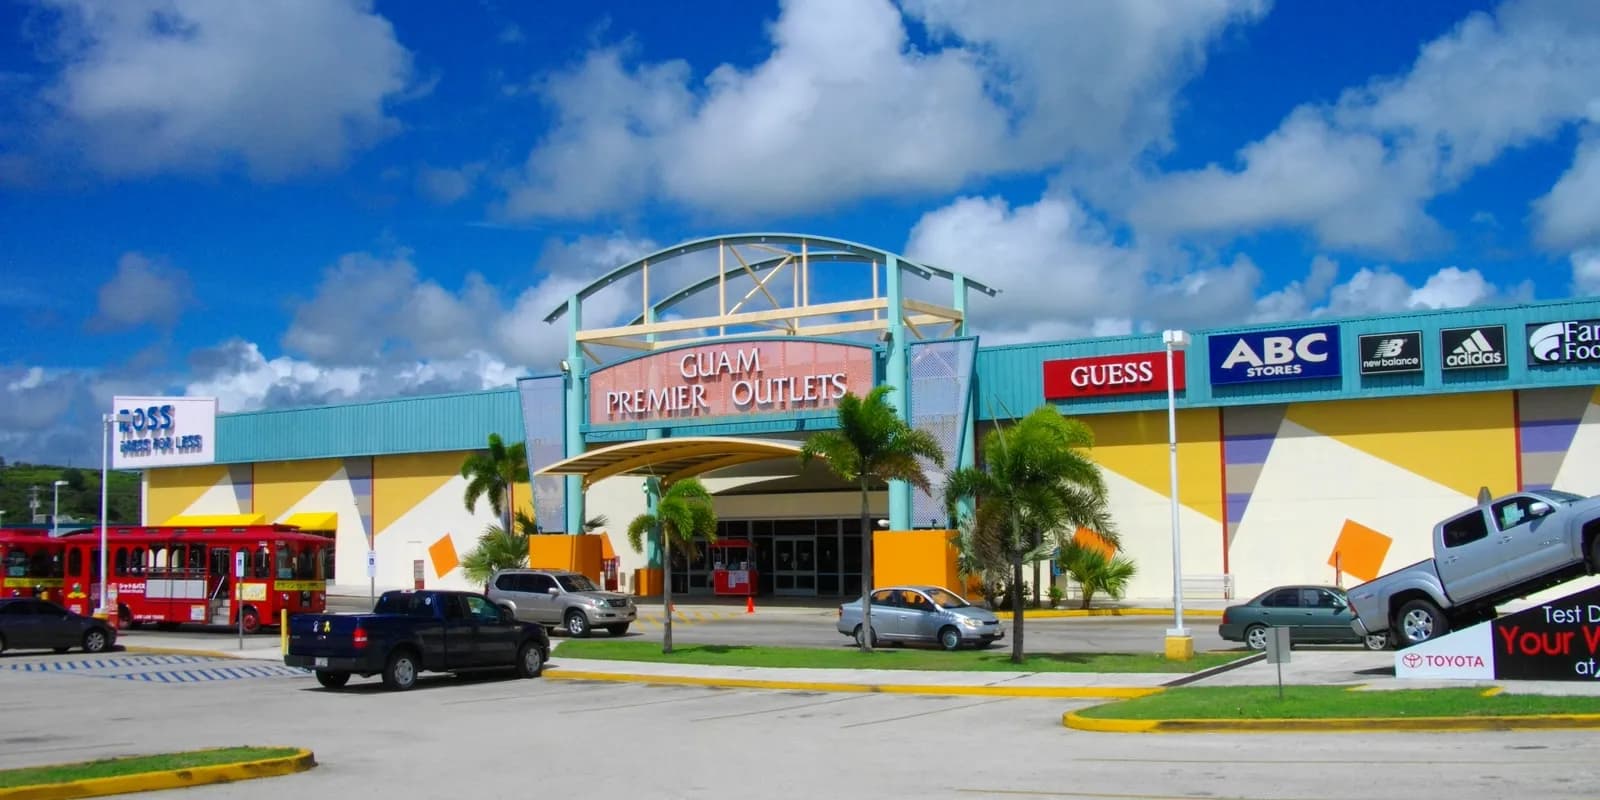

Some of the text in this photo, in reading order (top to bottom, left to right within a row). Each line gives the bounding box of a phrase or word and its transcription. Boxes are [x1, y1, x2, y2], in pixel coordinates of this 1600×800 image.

[1221, 332, 1328, 368] ABC
[1446, 351, 1502, 366] adidas
[680, 347, 761, 379] GUAM
[1246, 364, 1302, 377] STORES
[1363, 356, 1419, 368] new balance
[1070, 361, 1153, 387] GUESS
[606, 372, 847, 414] PREMIER OUTLETS
[175, 434, 203, 449] LESS
[1542, 604, 1582, 623] Test
[1499, 625, 1575, 656] Your
[1425, 655, 1484, 668] TOYOTA
[1575, 658, 1596, 675] at
